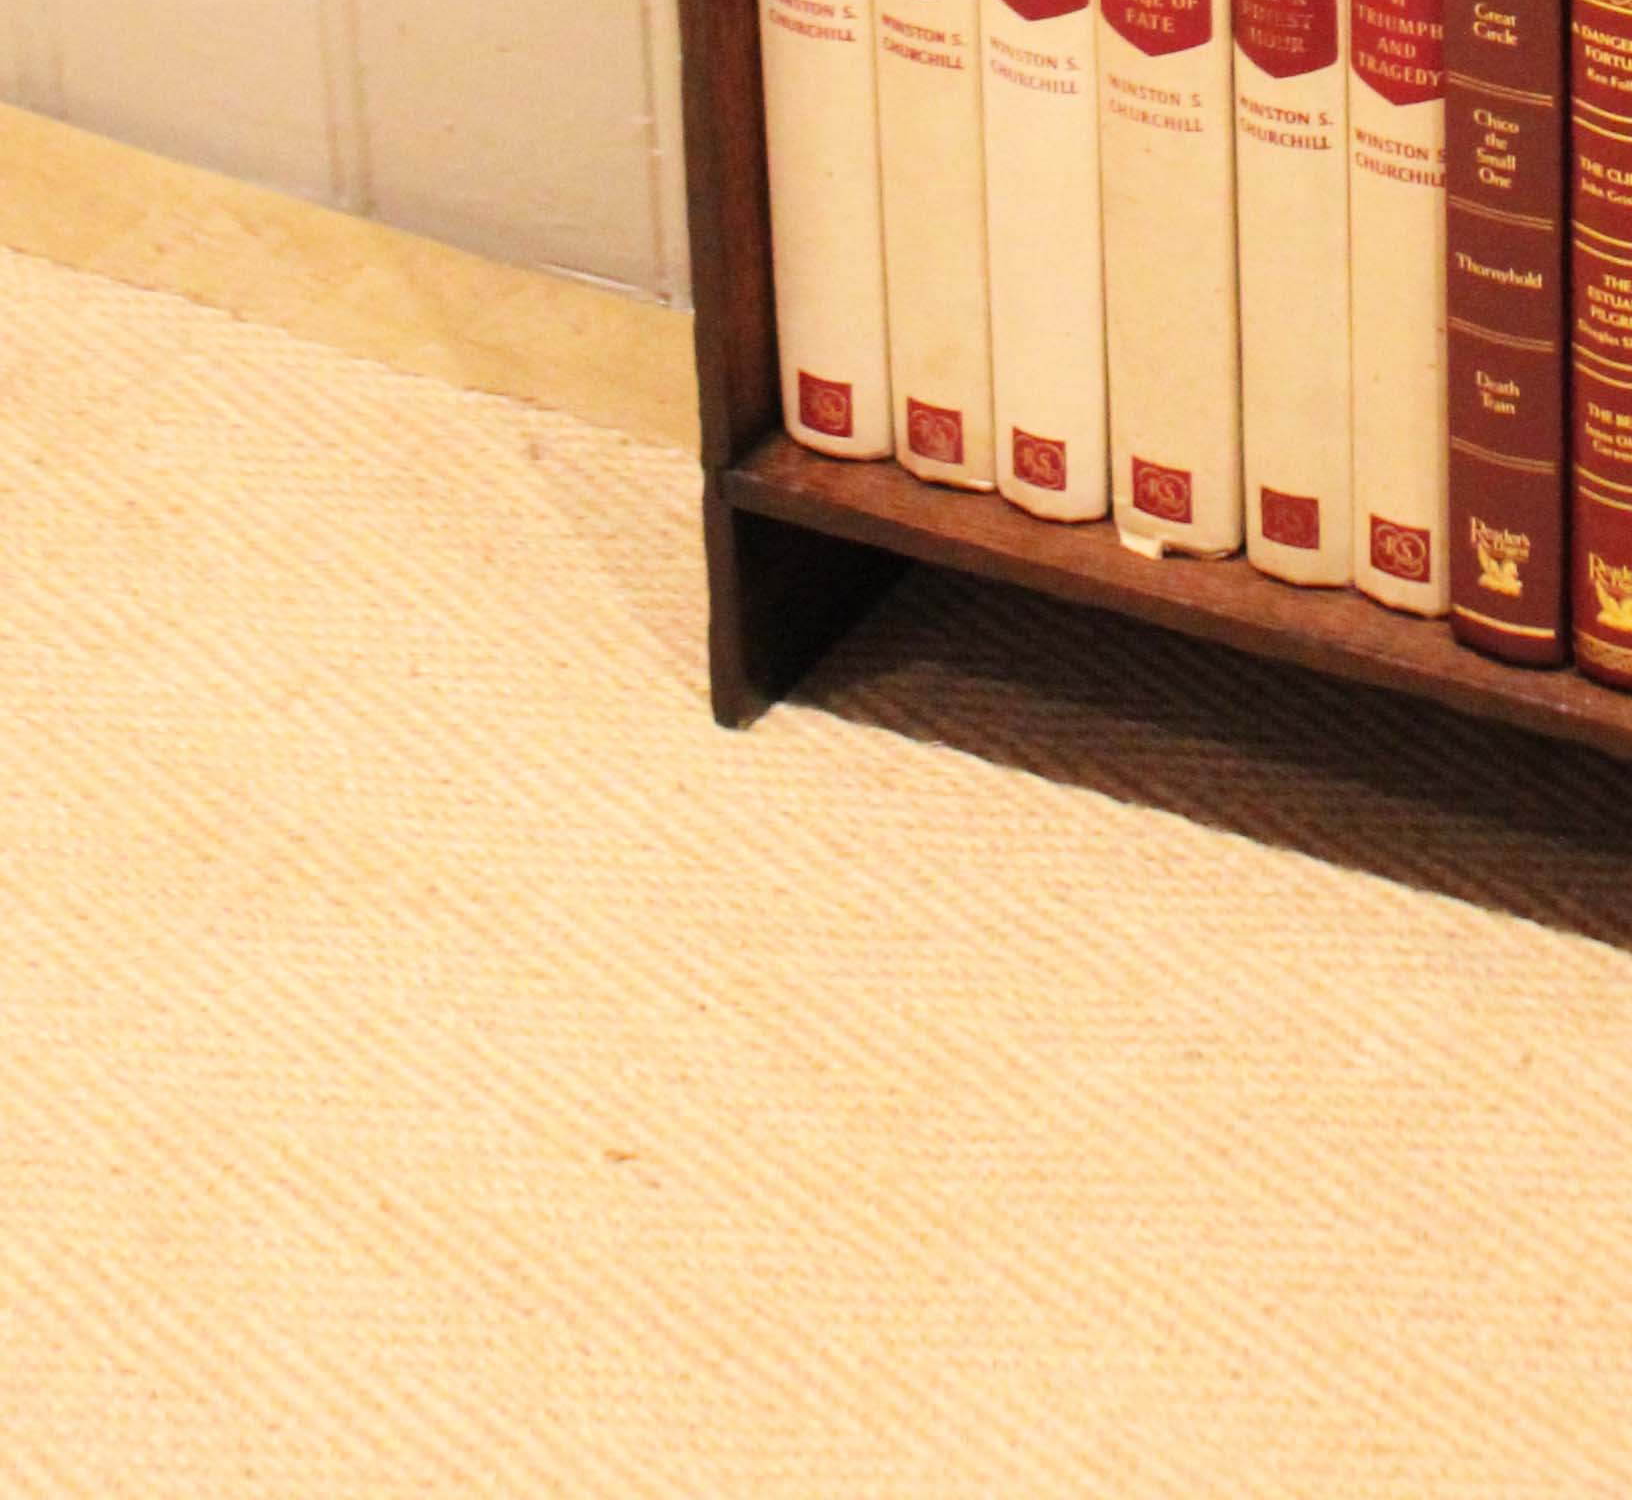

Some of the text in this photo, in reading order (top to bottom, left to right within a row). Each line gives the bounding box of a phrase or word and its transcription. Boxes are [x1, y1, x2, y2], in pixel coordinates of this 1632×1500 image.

[883, 13, 945, 44] WINSTON
[1123, 8, 1176, 35] FATE
[1357, 4, 1444, 39] TRIUMPH
[883, 37, 964, 69] CHURCHILL
[990, 37, 1058, 70] WINSTON
[1377, 37, 1416, 59] AND
[990, 60, 1078, 94] CHURCHILL
[1357, 51, 1442, 87] TRAGEDY
[1108, 73, 1180, 106] WINSTON
[1108, 98, 1203, 132] CHURCHILL
[1239, 96, 1310, 125] WINSTON
[1473, 108, 1519, 134] Chico
[1240, 118, 1332, 150] CHURCHILL
[1354, 127, 1429, 161] WINSTON
[1484, 132, 1508, 151] the
[1455, 251, 1542, 289] Thornyhold
[1604, 274, 1632, 293] THE
[1587, 401, 1613, 425] THE
